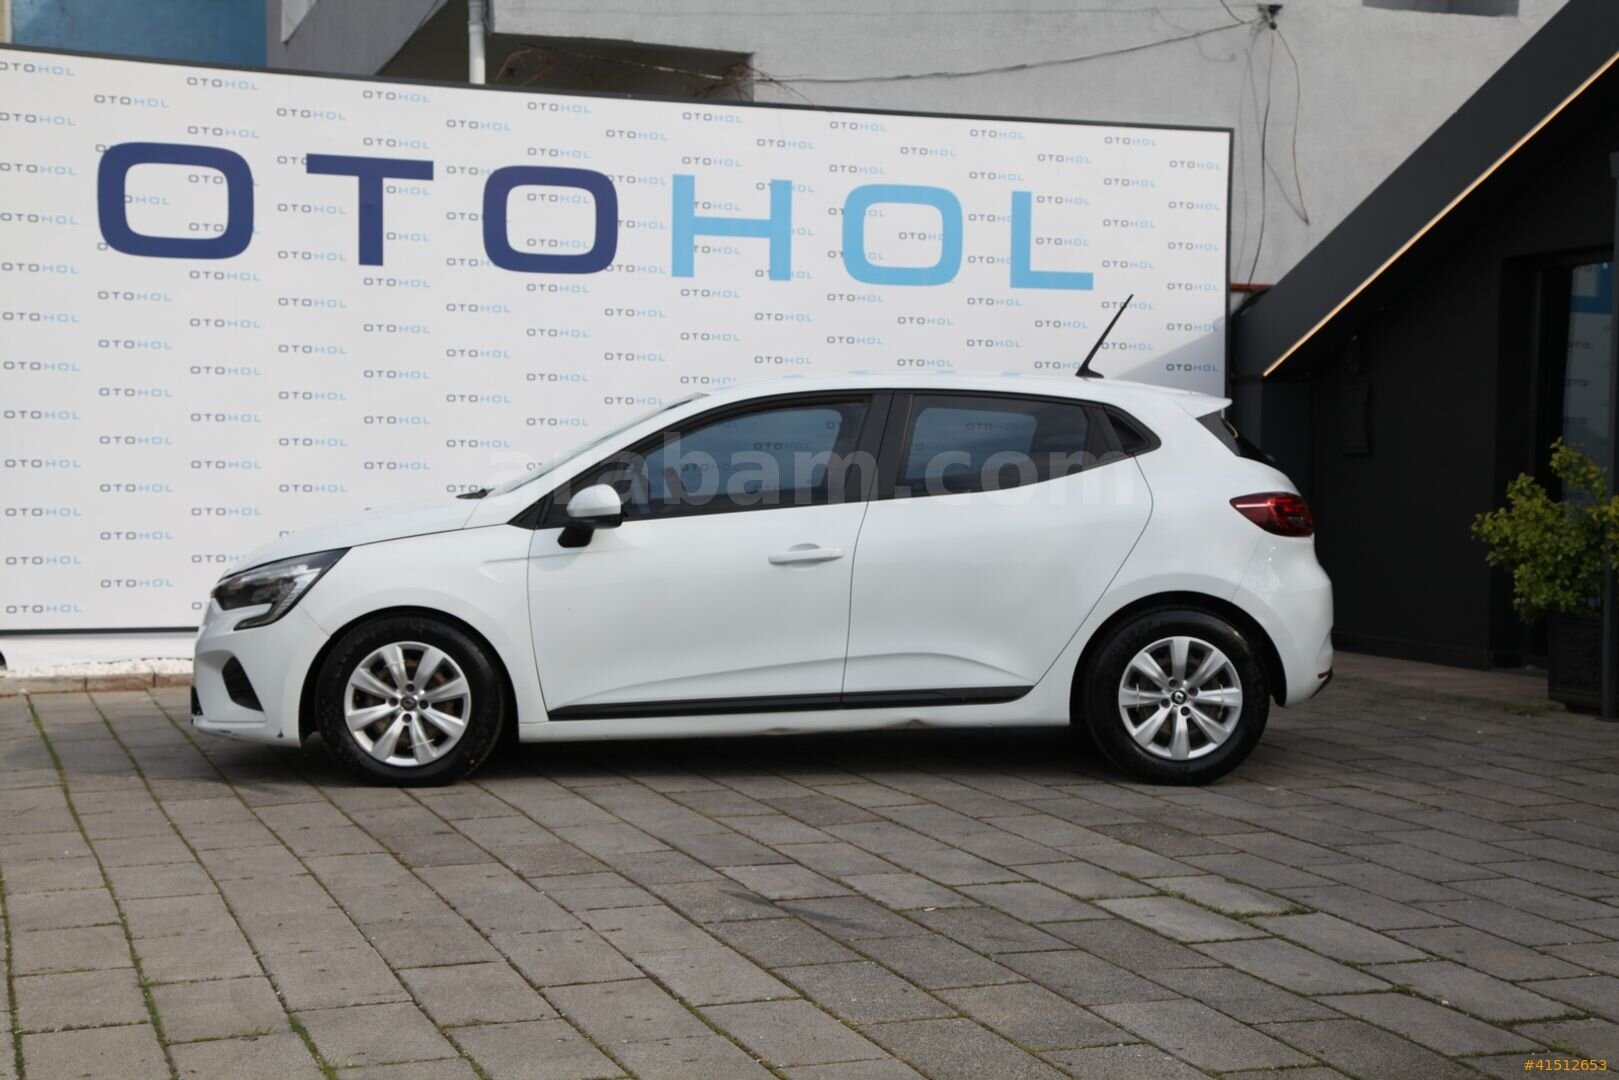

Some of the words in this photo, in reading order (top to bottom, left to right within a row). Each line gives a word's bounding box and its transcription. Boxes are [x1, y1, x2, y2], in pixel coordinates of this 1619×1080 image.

[187, 77, 259, 90] OTOHOL
[363, 90, 430, 102] OTOHOL
[94, 95, 170, 107] OTOHOL
[527, 102, 590, 113] OTOHOL
[276, 108, 343, 120] OTOHOL
[682, 112, 744, 123] OTOHOL
[0, 112, 76, 126] OTOHOL
[446, 120, 513, 131] OTOHOL
[830, 121, 886, 131] OTOHOL
[187, 126, 259, 138] OTOHOL
[606, 130, 667, 140] OTOHOL
[970, 129, 1026, 139] OTOHOL
[363, 137, 430, 149] OTOHOL
[757, 139, 815, 149] OTOHOL
[1105, 137, 1156, 145] OTOHOL
[527, 148, 590, 158] OTOHOL
[900, 147, 956, 156] OTOHOL
[682, 156, 742, 166] OTOHOL
[1037, 154, 1090, 163] OTOHOL
[0, 162, 78, 175] OTOHOL
[1169, 160, 1222, 169] OTOHOL
[446, 166, 490, 176] OTOH
[829, 165, 886, 174] OTOHOL
[969, 172, 1024, 181] OTOHOL
[1104, 178, 1156, 187] OTOHOL
[386, 186, 431, 197] OHOL
[124, 195, 170, 206] OHOL
[527, 193, 589, 203] OTOHOL
[1037, 195, 1090, 205] OTOHOL
[277, 203, 345, 214] OTOHOL
[694, 200, 742, 211] TOHOL
[1168, 201, 1221, 210] OTOHOL
[0, 213, 78, 224] OTOHOL
[97, 142, 1093, 291] OTOHOL
[618, 219, 667, 231] TOHOL
[1103, 219, 1154, 228] OTOHOL
[386, 232, 431, 242] OHOL
[1036, 237, 1090, 246] OTOHOL
[527, 238, 588, 248] OTOHOL
[1168, 242, 1220, 251] OTOHOL
[694, 244, 741, 255] TOHOL
[278, 251, 346, 261] OTOHOL
[1, 262, 79, 273] OTOHOL
[446, 258, 490, 268] OTOH
[1102, 260, 1154, 268] OTOHOL
[189, 270, 261, 281] OTOHOL
[363, 277, 431, 288] OTOHOL
[1167, 283, 1218, 291] OTOHOL
[526, 284, 589, 293] OTOHOL
[97, 291, 172, 301] OTOHOL
[680, 289, 741, 298] OTOHOL
[827, 293, 884, 302] OTOHOL
[278, 298, 348, 308] OTOHOL
[967, 297, 1023, 306] OTOHOL
[446, 304, 512, 312] OTOHOL
[605, 308, 666, 317] OTOHOL
[2, 312, 80, 322] OTOHOL
[754, 313, 814, 321] OTOHOL
[897, 317, 954, 325] OTOHOL
[190, 318, 262, 328] OTOHOL
[1035, 320, 1090, 328] OTOHOL
[1166, 323, 1218, 331] OTOHOL
[363, 324, 431, 333] OTOHOL
[526, 328, 590, 337] OTOHOL
[680, 332, 740, 341] OTOHOL
[827, 336, 884, 344] OTOHOL
[98, 339, 172, 349] OTOHOL
[966, 339, 1022, 347] OTOHOL
[278, 344, 348, 354] OTOHOL
[446, 349, 510, 358] OTOHOL
[604, 353, 666, 361] OTOHOL
[754, 356, 813, 364] OTOHOL
[3, 361, 81, 371] OTOHOL
[897, 359, 954, 367] OTOHOL
[1034, 361, 1080, 370] OTOHO
[1166, 363, 1218, 371] OTOHOL
[190, 366, 262, 375] OTOHOL
[364, 370, 432, 379] OTOHOL
[526, 373, 590, 382] OTOHOL
[99, 388, 172, 397] OTOHOL
[279, 391, 348, 400] OTOHOL
[446, 394, 512, 403] OTOHOL
[3, 410, 82, 420] OTOHOL
[191, 413, 262, 422] OTOHOL
[364, 416, 431, 424] OTOHOL
[526, 418, 590, 426] OTOHOL
[99, 436, 172, 445] OTOHOL
[279, 438, 347, 446] OTOHOL
[446, 440, 512, 448] OTOHOL
[4, 459, 82, 468] OTOHOL
[191, 460, 262, 469] OTOHOL
[364, 461, 431, 470] OTOHOL
[100, 484, 172, 492] OTOHOL
[279, 484, 347, 492] OTOHOL
[5, 508, 82, 517] OTOHOL
[191, 507, 263, 516] OTOHOL
[100, 531, 173, 540] OTOHOL
[5, 556, 82, 565] OTOHOL
[191, 554, 246, 564] OTOH
[100, 579, 174, 588] OTOHOL
[6, 604, 82, 614] OTOHOL
